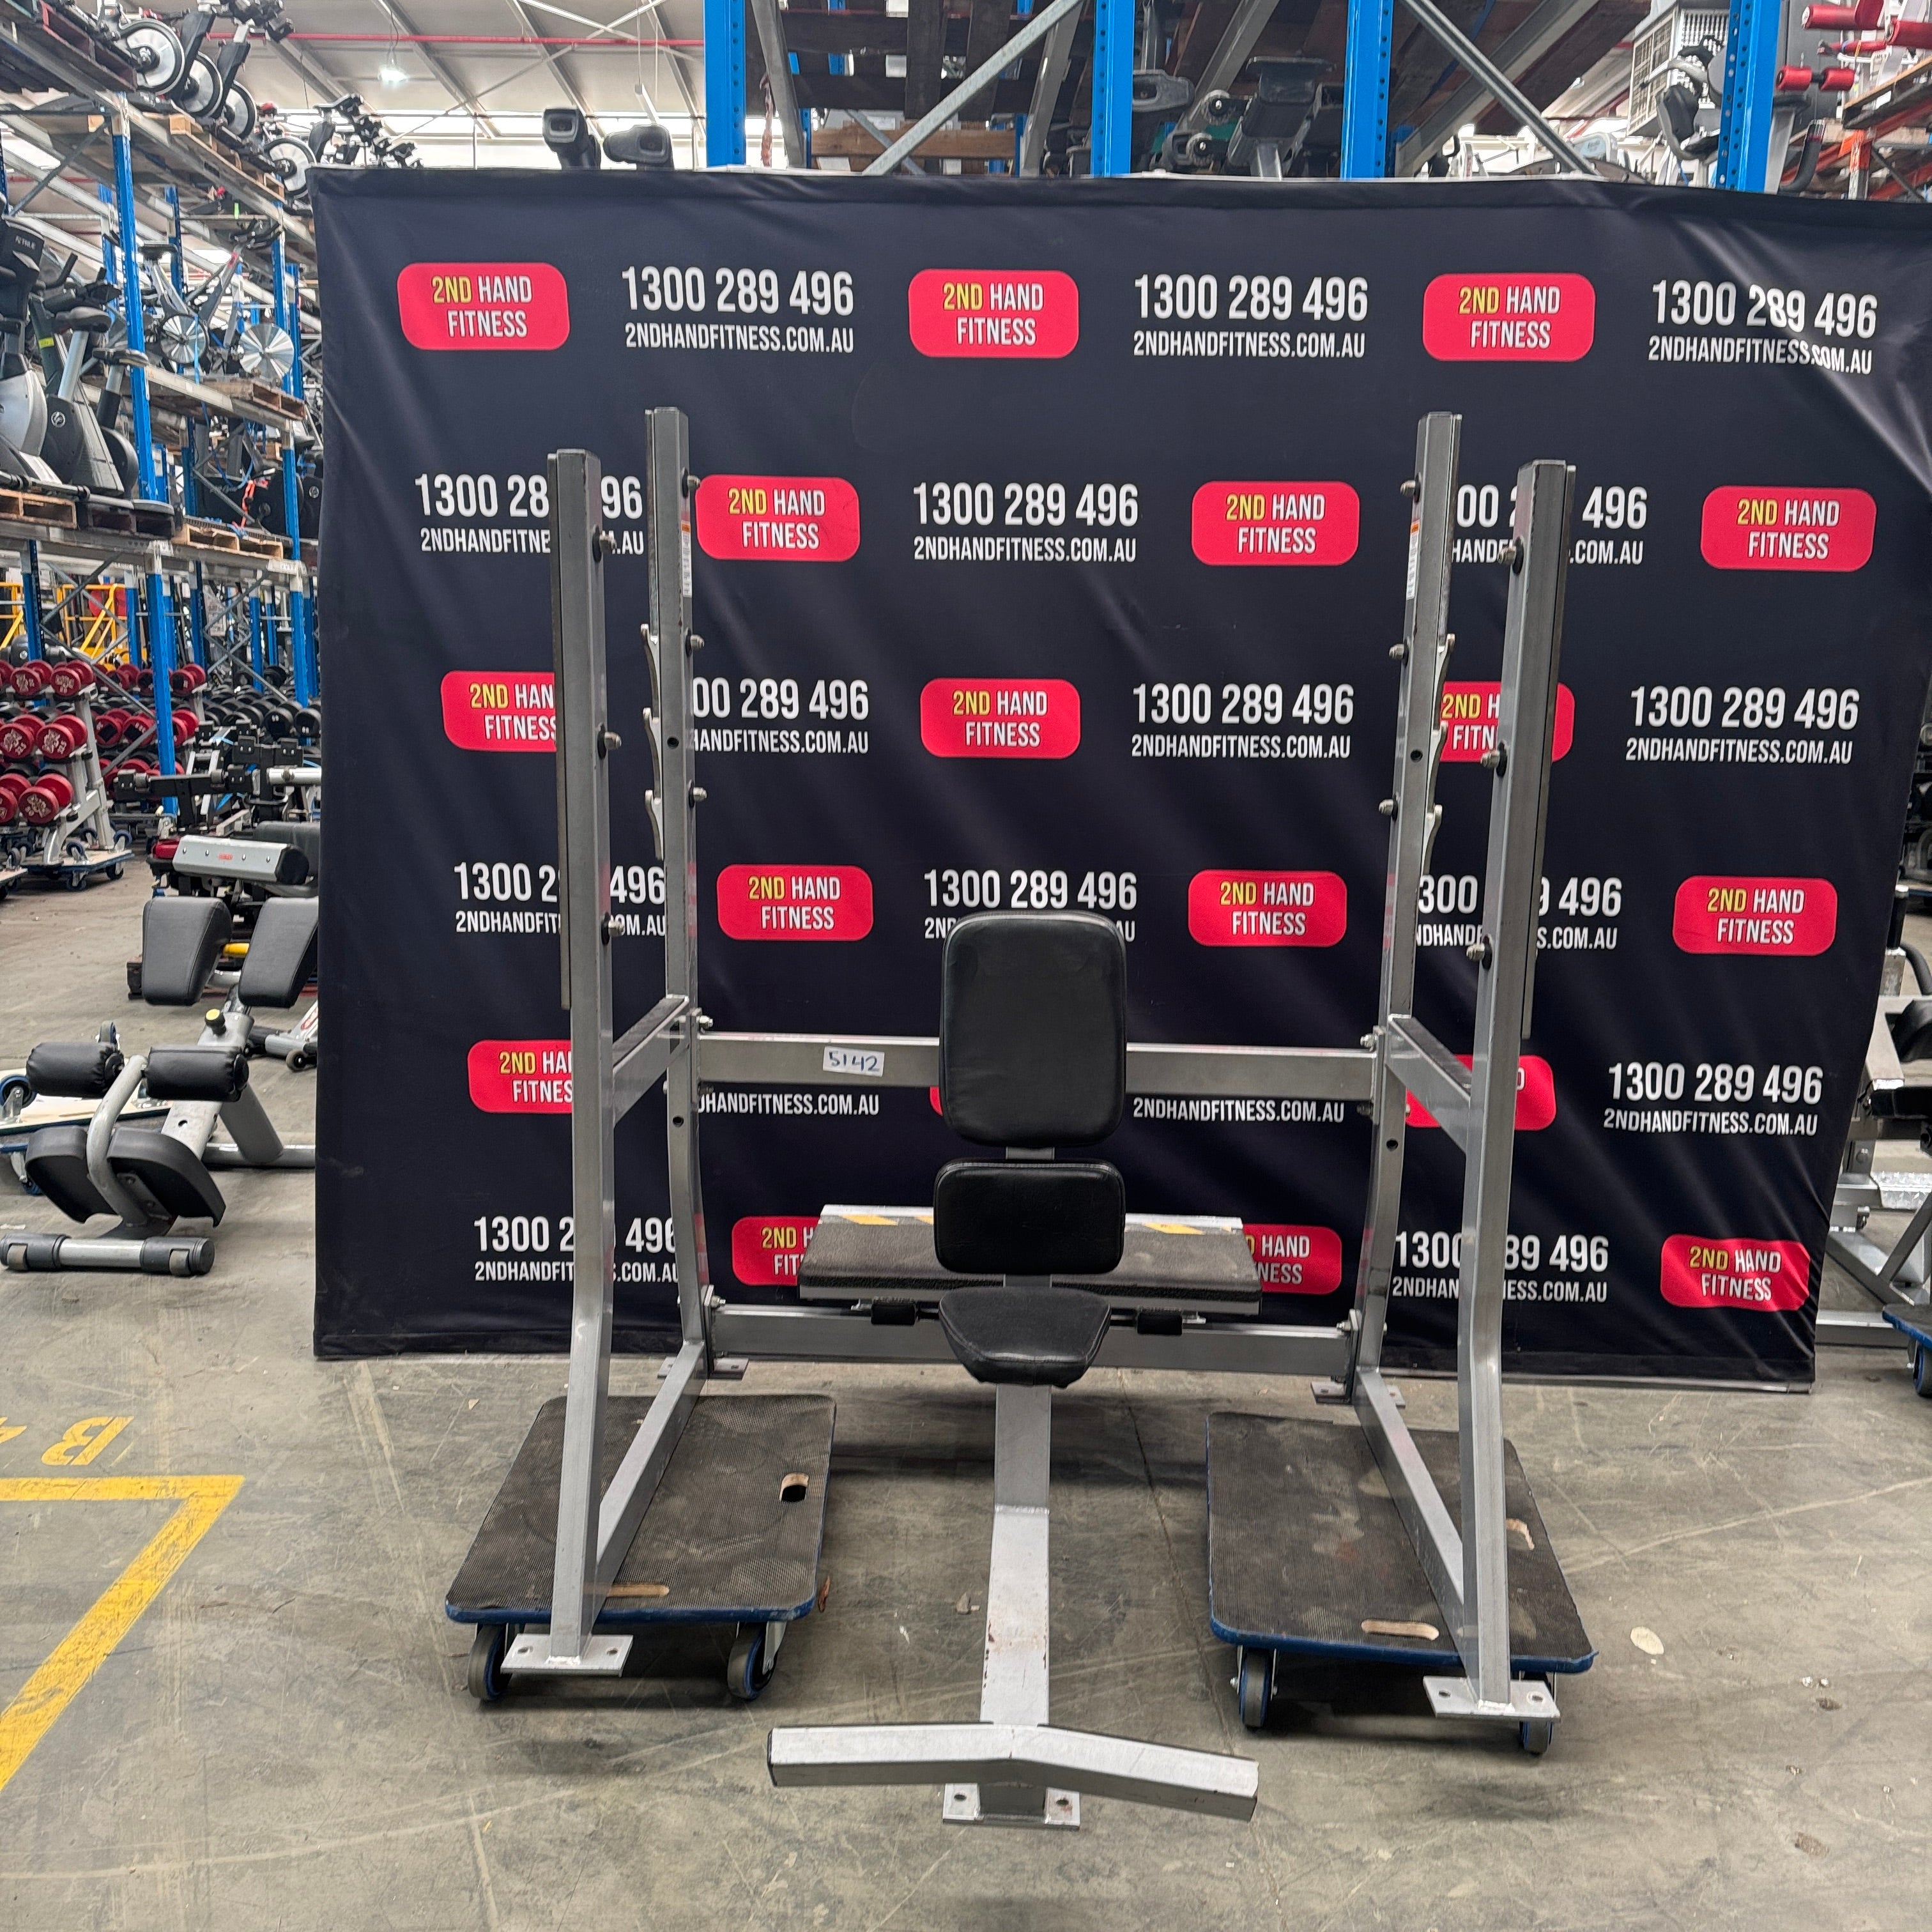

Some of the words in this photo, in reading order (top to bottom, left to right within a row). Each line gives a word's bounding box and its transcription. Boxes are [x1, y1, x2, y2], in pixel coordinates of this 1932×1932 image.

[432, 276, 471, 303] 2ND
[478, 275, 532, 303] HAND
[622, 266, 705, 312] 1300
[716, 267, 779, 314] 289
[789, 270, 854, 316] 496
[943, 282, 983, 310] 2ND
[990, 283, 1043, 310] HAND
[1135, 274, 1218, 319] 1300
[1229, 275, 1292, 321] 289
[1302, 277, 1368, 321] 496
[1459, 287, 1499, 314] 2ND
[1506, 286, 1560, 314] HAND
[447, 310, 527, 337] FITNESS
[1652, 280, 1736, 326] 1300
[1746, 284, 1805, 333] 289
[1814, 293, 1878, 339] 496
[625, 322, 854, 353] 2NDHANDFITNESS.COM.AU
[957, 317, 1036, 346] FITNESS
[1133, 330, 1365, 358] 2NDHANDFITNESS.COM.AU
[1471, 320, 1551, 349] FITNESS
[1648, 335, 1873, 375] 2NDHANDFITNESS.COM.AU
[415, 473, 498, 517] 1300
[507, 474, 549, 518] 28
[600, 475, 643, 519] 96
[728, 488, 767, 515] 2ND
[774, 489, 825, 516] HAND
[913, 482, 993, 526] 1300
[1004, 482, 1066, 526] 289
[1075, 483, 1138, 527] 496
[1226, 494, 1265, 520] 2ND
[1272, 494, 1325, 520] HAND
[1457, 484, 1499, 528] 00
[1582, 486, 1648, 530] 496
[1737, 499, 1778, 525] 2ND
[1784, 500, 1839, 526] HAND
[742, 521, 819, 549] FITNESS
[914, 535, 1136, 562] 2NDHANDFITNESS.COM.AU
[1238, 527, 1316, 554] FITNESS
[1748, 531, 1829, 559] FITNESS
[469, 682, 509, 709] 2ND
[514, 683, 554, 709] HAN
[693, 677, 731, 718] 00
[739, 678, 799, 719] 289
[809, 679, 869, 720] 496
[953, 690, 990, 716] 2ND
[997, 691, 1047, 716] HAND
[1133, 683, 1211, 724] 1300
[1222, 684, 1283, 724] 289
[1292, 684, 1354, 724] 496
[1441, 693, 1482, 719] 2ND
[1630, 686, 1713, 728] 1300
[1721, 687, 1786, 729] 289
[1793, 688, 1860, 730] 496
[966, 721, 1040, 747] FITNESS
[1131, 733, 1351, 758] 2NDHANDFITNESS.COM.AU
[1452, 724, 1495, 751] FITN
[1625, 737, 1853, 764] 2NDHANDFITNESS.COM.AU
[454, 861, 532, 901] 1300
[610, 865, 665, 905] 496
[749, 876, 785, 900] 2ND
[791, 876, 840, 900] HAND
[924, 869, 1001, 908] 1300
[1009, 870, 1068, 909] 289
[1077, 871, 1137, 910] 496
[1220, 881, 1257, 905] 2ND
[1263, 882, 1314, 906] HAND
[1418, 874, 1478, 914] 300
[1558, 877, 1622, 917] 496
[1707, 887, 1747, 912] 2ND
[1753, 889, 1805, 914] HAND
[762, 906, 834, 930] FITNESS
[1232, 911, 1306, 935] FITNESS
[1717, 918, 1795, 944] FITNESS
[499, 1051, 537, 1075] 2ND
[542, 1050, 572, 1075] HA
[829, 1050, 880, 1072] 5142
[512, 1079, 572, 1103] FITNES
[1609, 1062, 1685, 1101] 1300
[1694, 1063, 1754, 1102] 289
[1763, 1064, 1823, 1105] 496
[699, 1091, 880, 1116] HANDFITNESS.COM.AU
[1133, 1096, 1346, 1123] 2NDHANDFITNESS.COM.AU
[1604, 1108, 1818, 1136] 2NDHANDFITNESS.COM.AU
[474, 1215, 550, 1253] 1300
[762, 1226, 797, 1249] 2ND
[1261, 1234, 1310, 1258] HAND
[1504, 1234, 1540, 1271] 89
[1549, 1234, 1609, 1273] 496
[1690, 1246, 1728, 1270] 2ND
[1734, 1249, 1781, 1273] HAND
[1256, 1261, 1303, 1285] NESS
[1701, 1273, 1772, 1301] FITNESS
